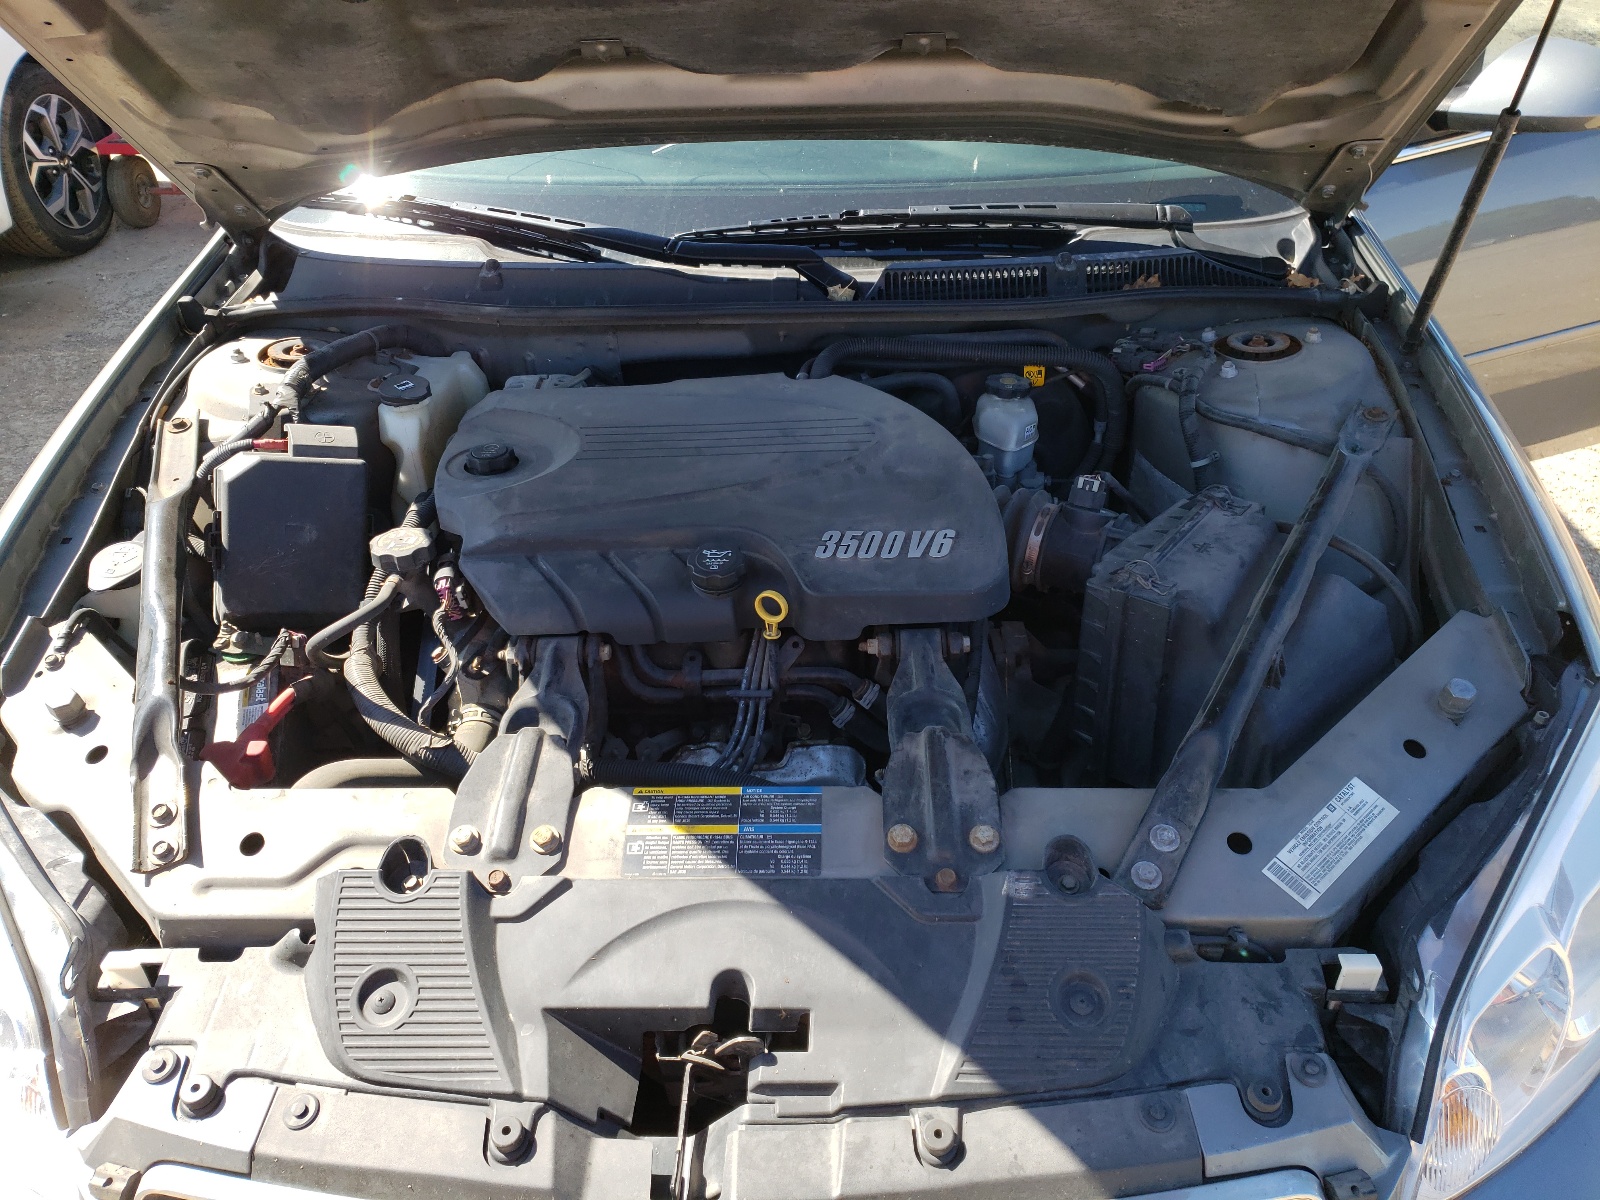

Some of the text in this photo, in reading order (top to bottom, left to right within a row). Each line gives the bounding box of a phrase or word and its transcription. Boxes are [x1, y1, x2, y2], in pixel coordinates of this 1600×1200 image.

[814, 528, 956, 559] 3500 V6
[1334, 782, 1356, 803] CATALYST
